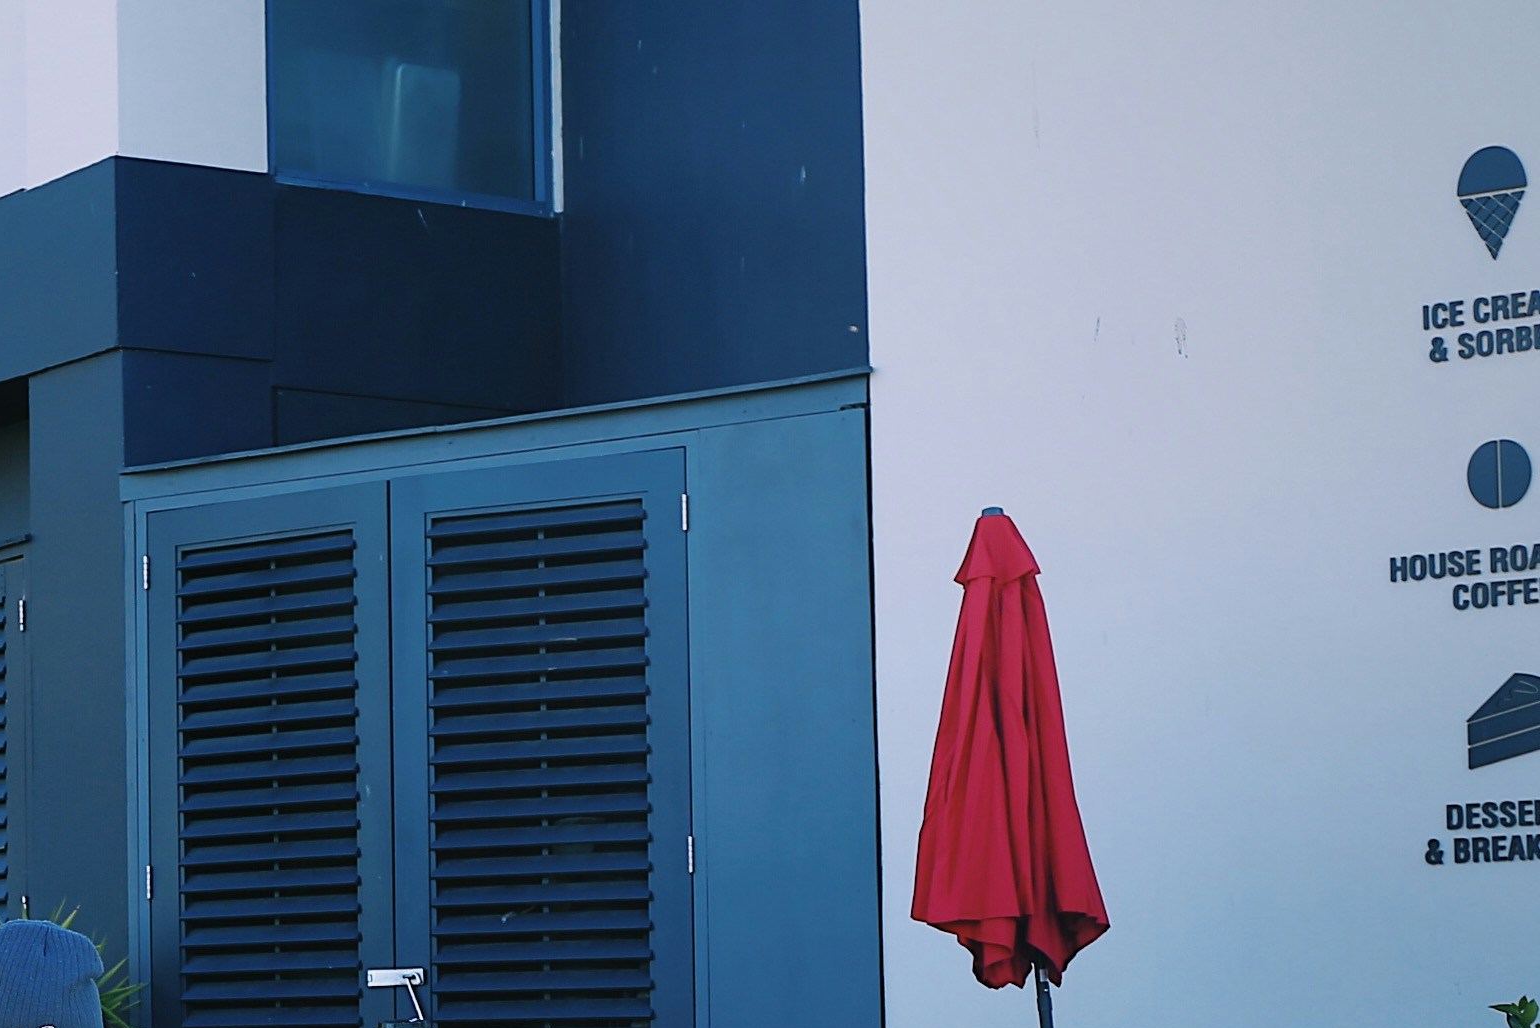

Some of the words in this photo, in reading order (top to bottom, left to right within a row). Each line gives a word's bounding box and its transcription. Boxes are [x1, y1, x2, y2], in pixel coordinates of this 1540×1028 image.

[1422, 300, 1464, 331] ICE
[1429, 336, 1449, 363] &
[1389, 549, 1481, 583] HOUSE
[1425, 838, 1444, 866] &
